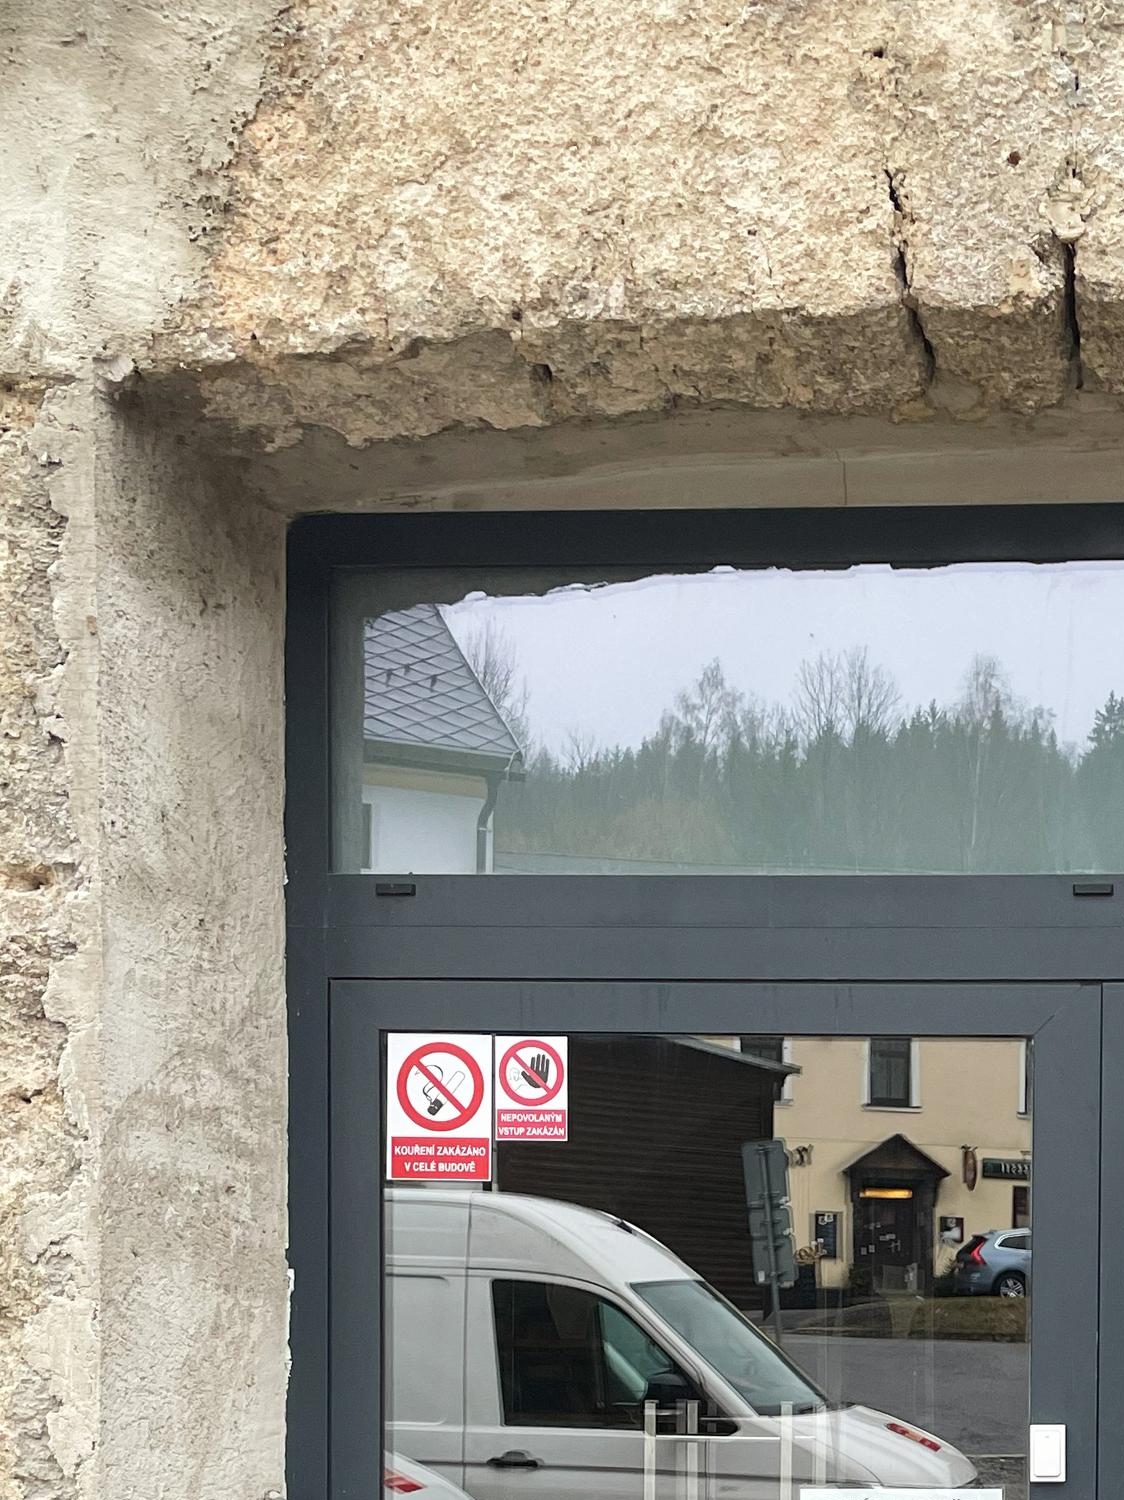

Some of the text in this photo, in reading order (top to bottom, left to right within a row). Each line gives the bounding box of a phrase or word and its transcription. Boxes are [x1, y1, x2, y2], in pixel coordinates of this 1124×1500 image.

[500, 1111, 562, 1122] NEPOVOLANÝM
[498, 1125, 565, 1136] VSTUP ZAKÁZÁN
[394, 1143, 486, 1156] KOUŘENÍ ZAKÁZÁNO
[404, 1160, 476, 1173] V CELÉ BUDOVĚ
